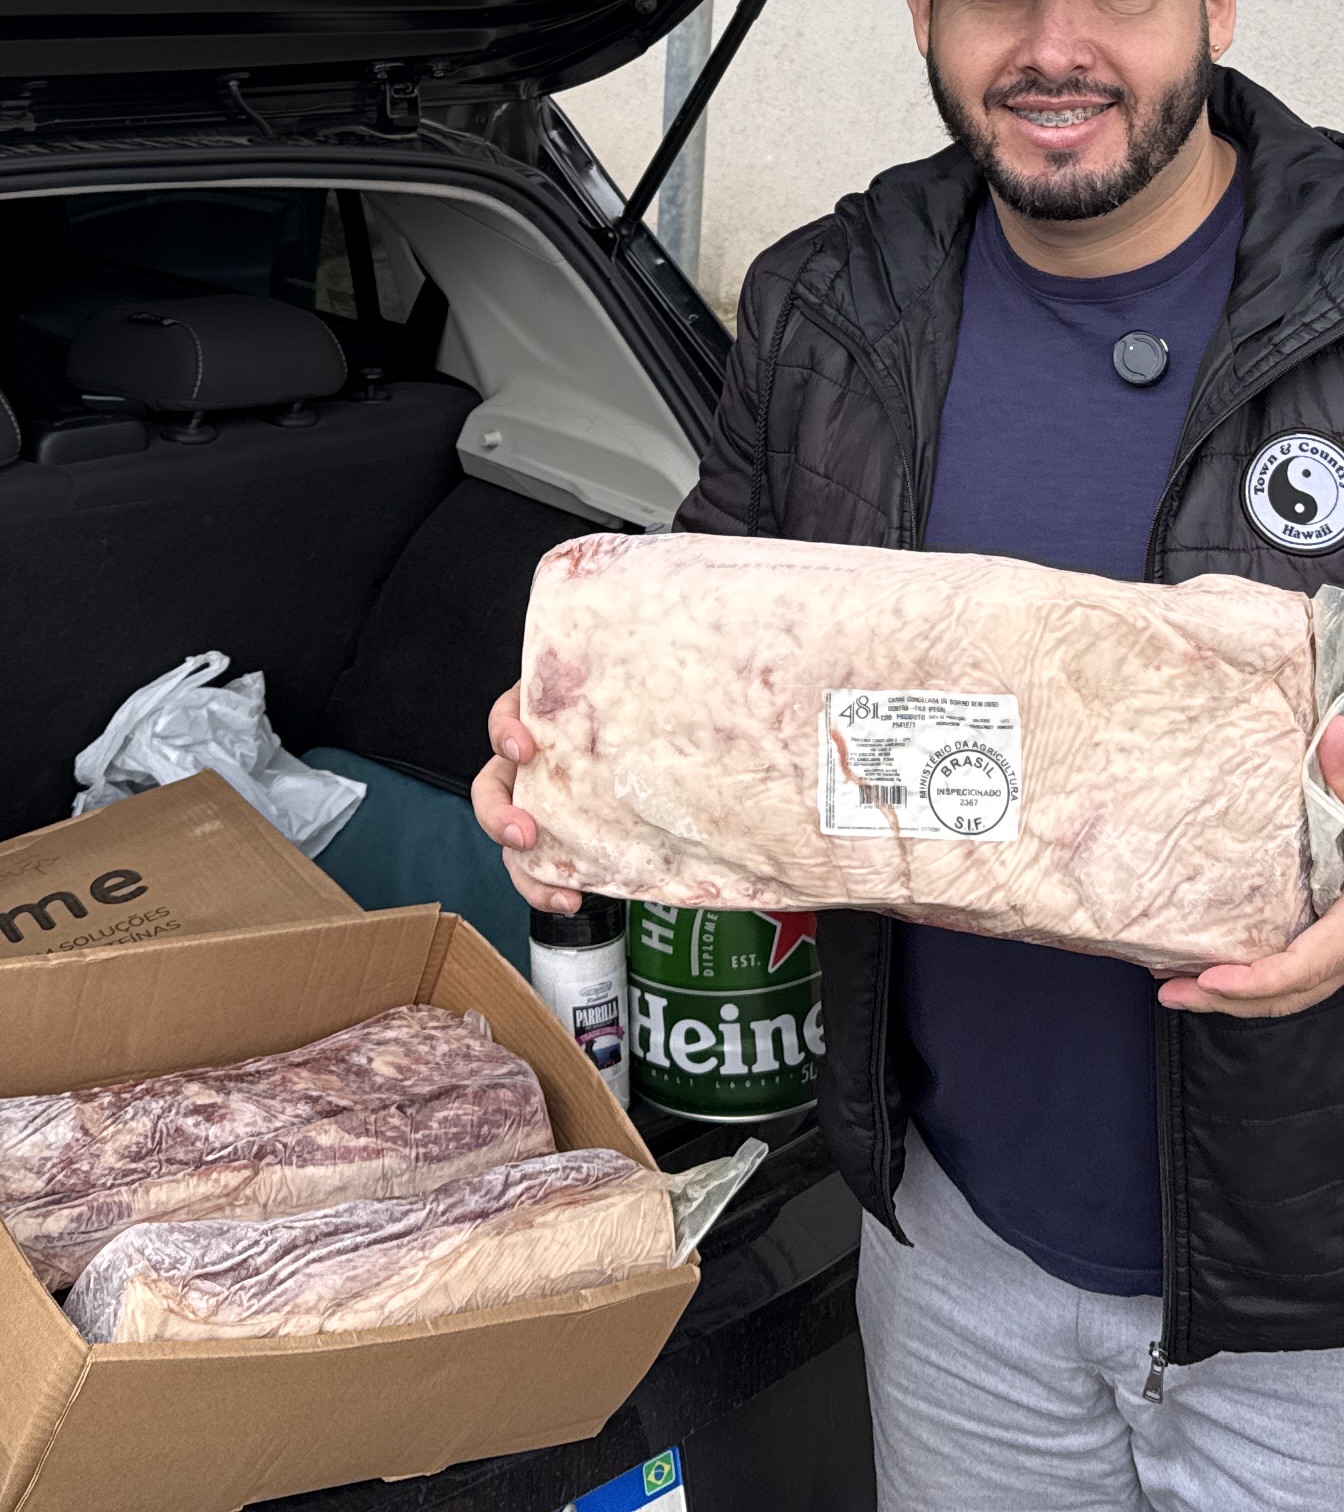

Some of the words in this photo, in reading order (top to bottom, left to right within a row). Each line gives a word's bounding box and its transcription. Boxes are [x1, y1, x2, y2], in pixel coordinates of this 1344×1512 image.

[1254, 454, 1278, 496] Town
[1279, 442, 1292, 455] &
[1282, 523, 1334, 540] Hawaii
[940, 755, 995, 779] BRASIL
[954, 740, 969, 749] DA
[971, 740, 1019, 801] AGRICULTURA
[936, 787, 1002, 797] INSPECIONADO
[59, 906, 171, 952] SOLUÇÕES
[731, 953, 762, 969] EST.
